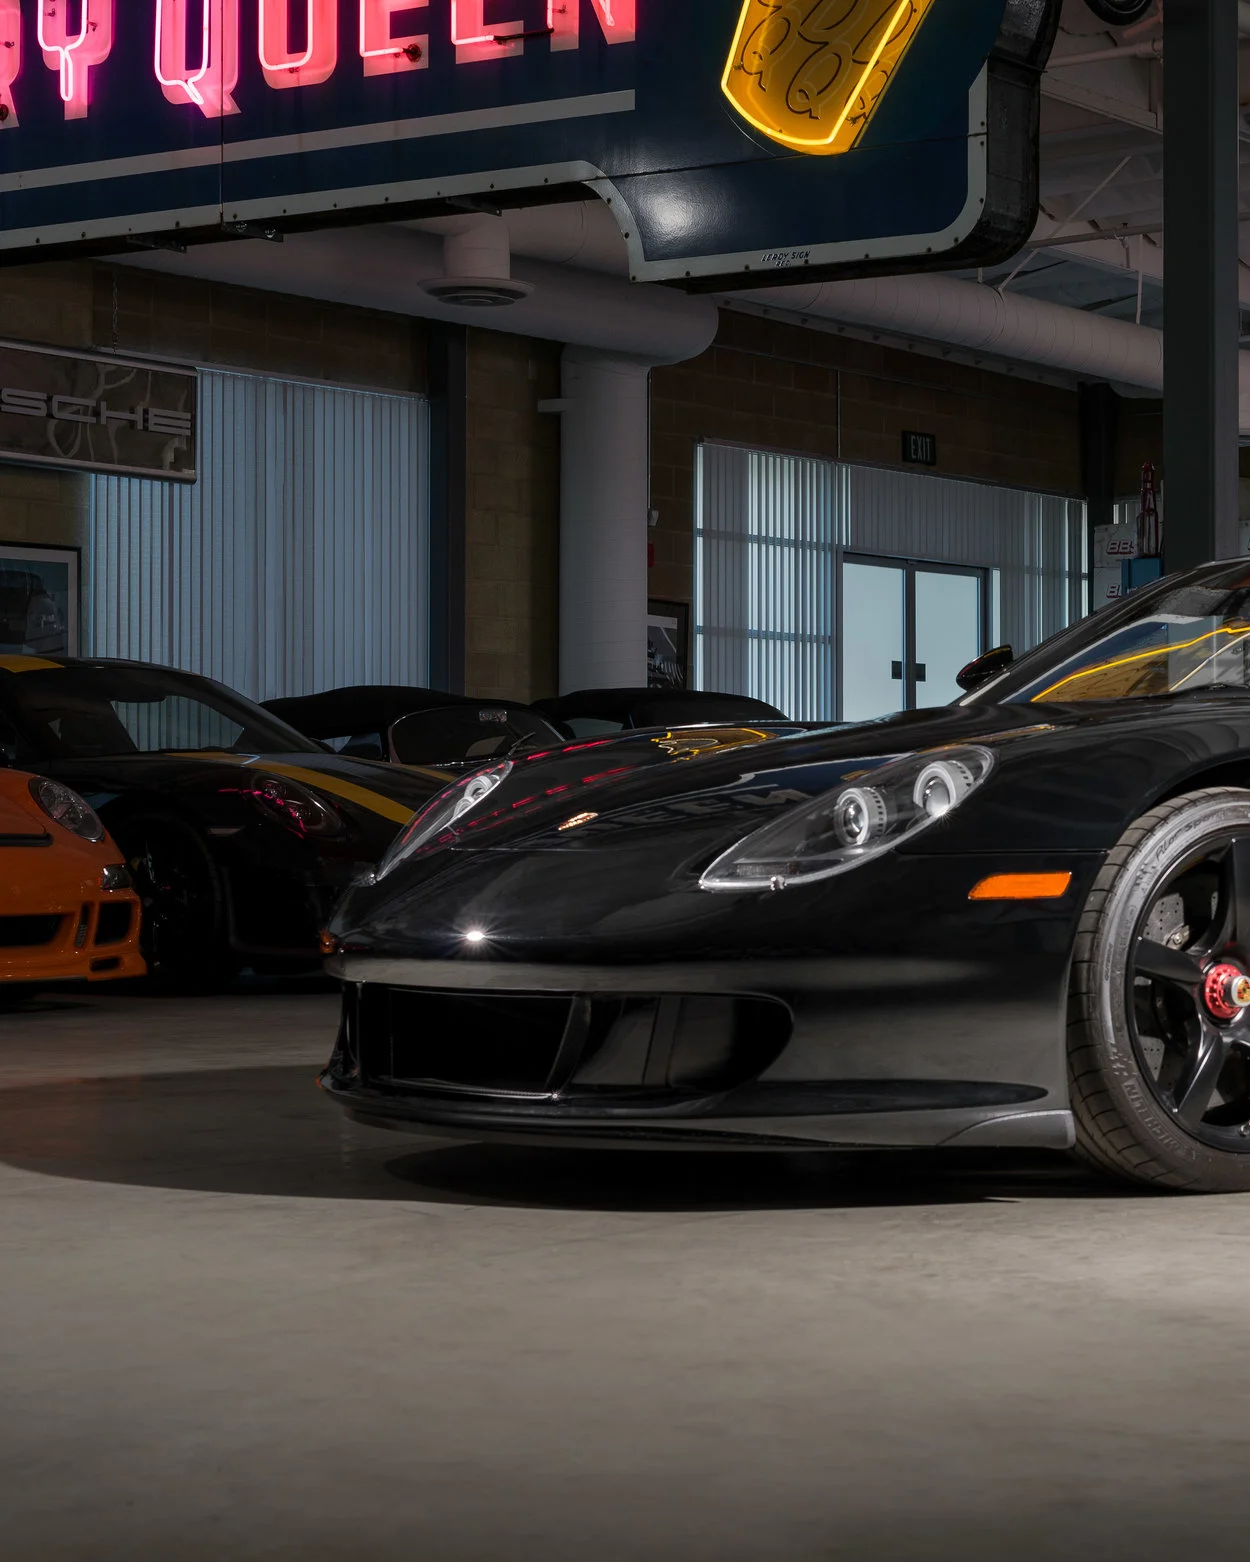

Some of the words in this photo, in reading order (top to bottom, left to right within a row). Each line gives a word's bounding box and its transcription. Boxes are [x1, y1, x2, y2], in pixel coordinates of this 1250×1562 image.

[155, 0, 637, 119] QUE
[791, 250, 811, 260] SIGN
[910, 435, 933, 461] EXIT
